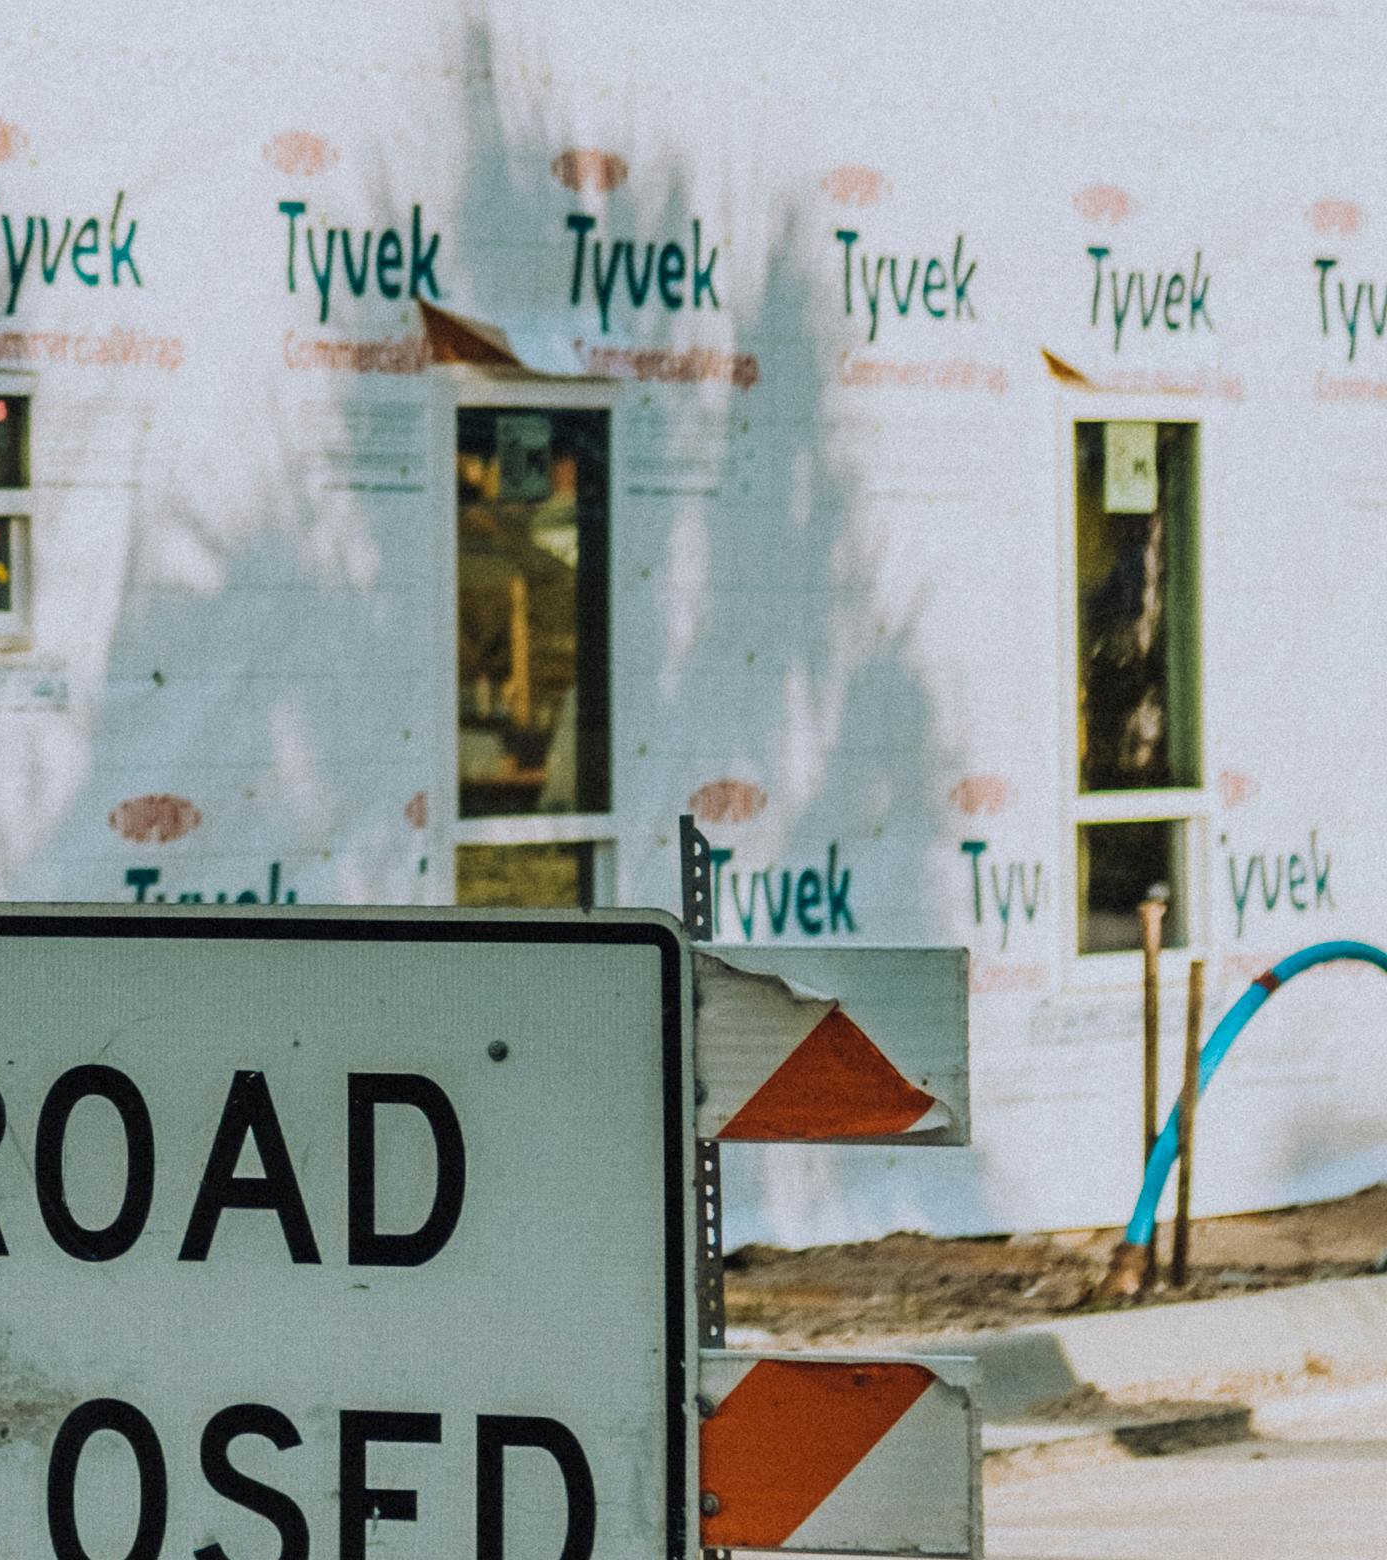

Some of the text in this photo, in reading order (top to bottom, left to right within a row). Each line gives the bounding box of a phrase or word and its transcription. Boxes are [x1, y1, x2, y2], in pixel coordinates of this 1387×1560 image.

[279, 202, 443, 324] Tyvek
[567, 215, 721, 333] Tyvek
[835, 229, 977, 342] Tyvek
[1088, 246, 1213, 352] Tyvek
[710, 841, 857, 939] Tyvek
